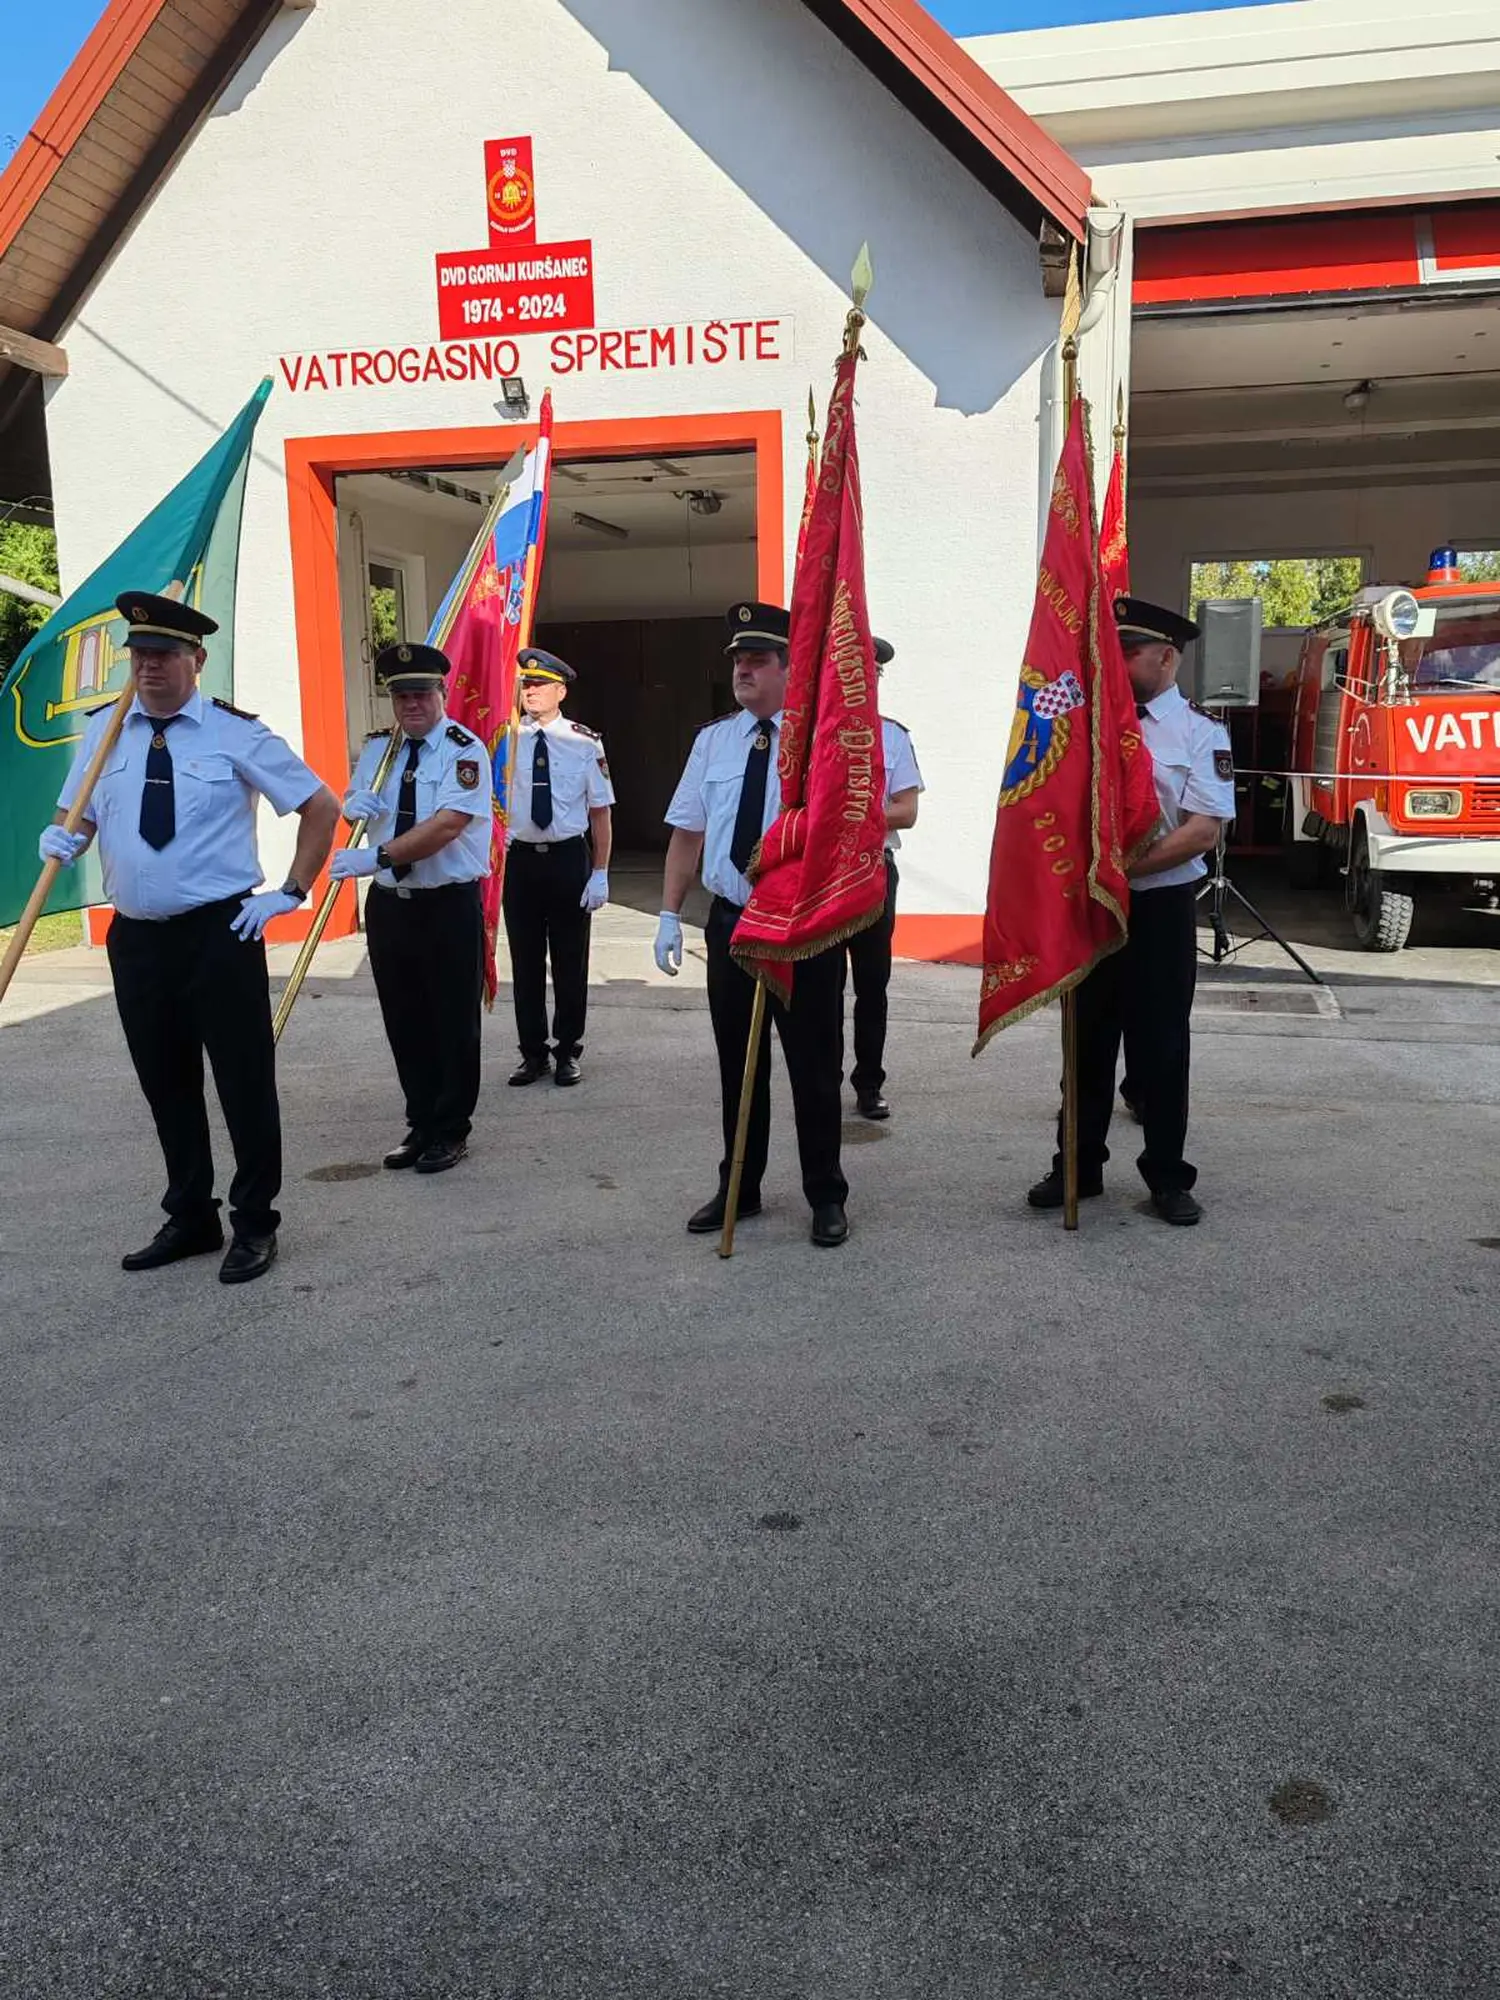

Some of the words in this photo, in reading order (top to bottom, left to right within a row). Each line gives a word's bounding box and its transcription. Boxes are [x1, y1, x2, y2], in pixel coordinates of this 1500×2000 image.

[440, 266, 466, 287] DVD
[468, 262, 516, 285] GORNJI
[517, 255, 588, 281] KURŠANEC
[462, 297, 503, 324] 1974
[518, 293, 566, 320] 2024
[280, 340, 520, 392] VATROGASNO
[550, 320, 780, 374] SPREMIŠTE
[1406, 712, 1500, 753] VAT
